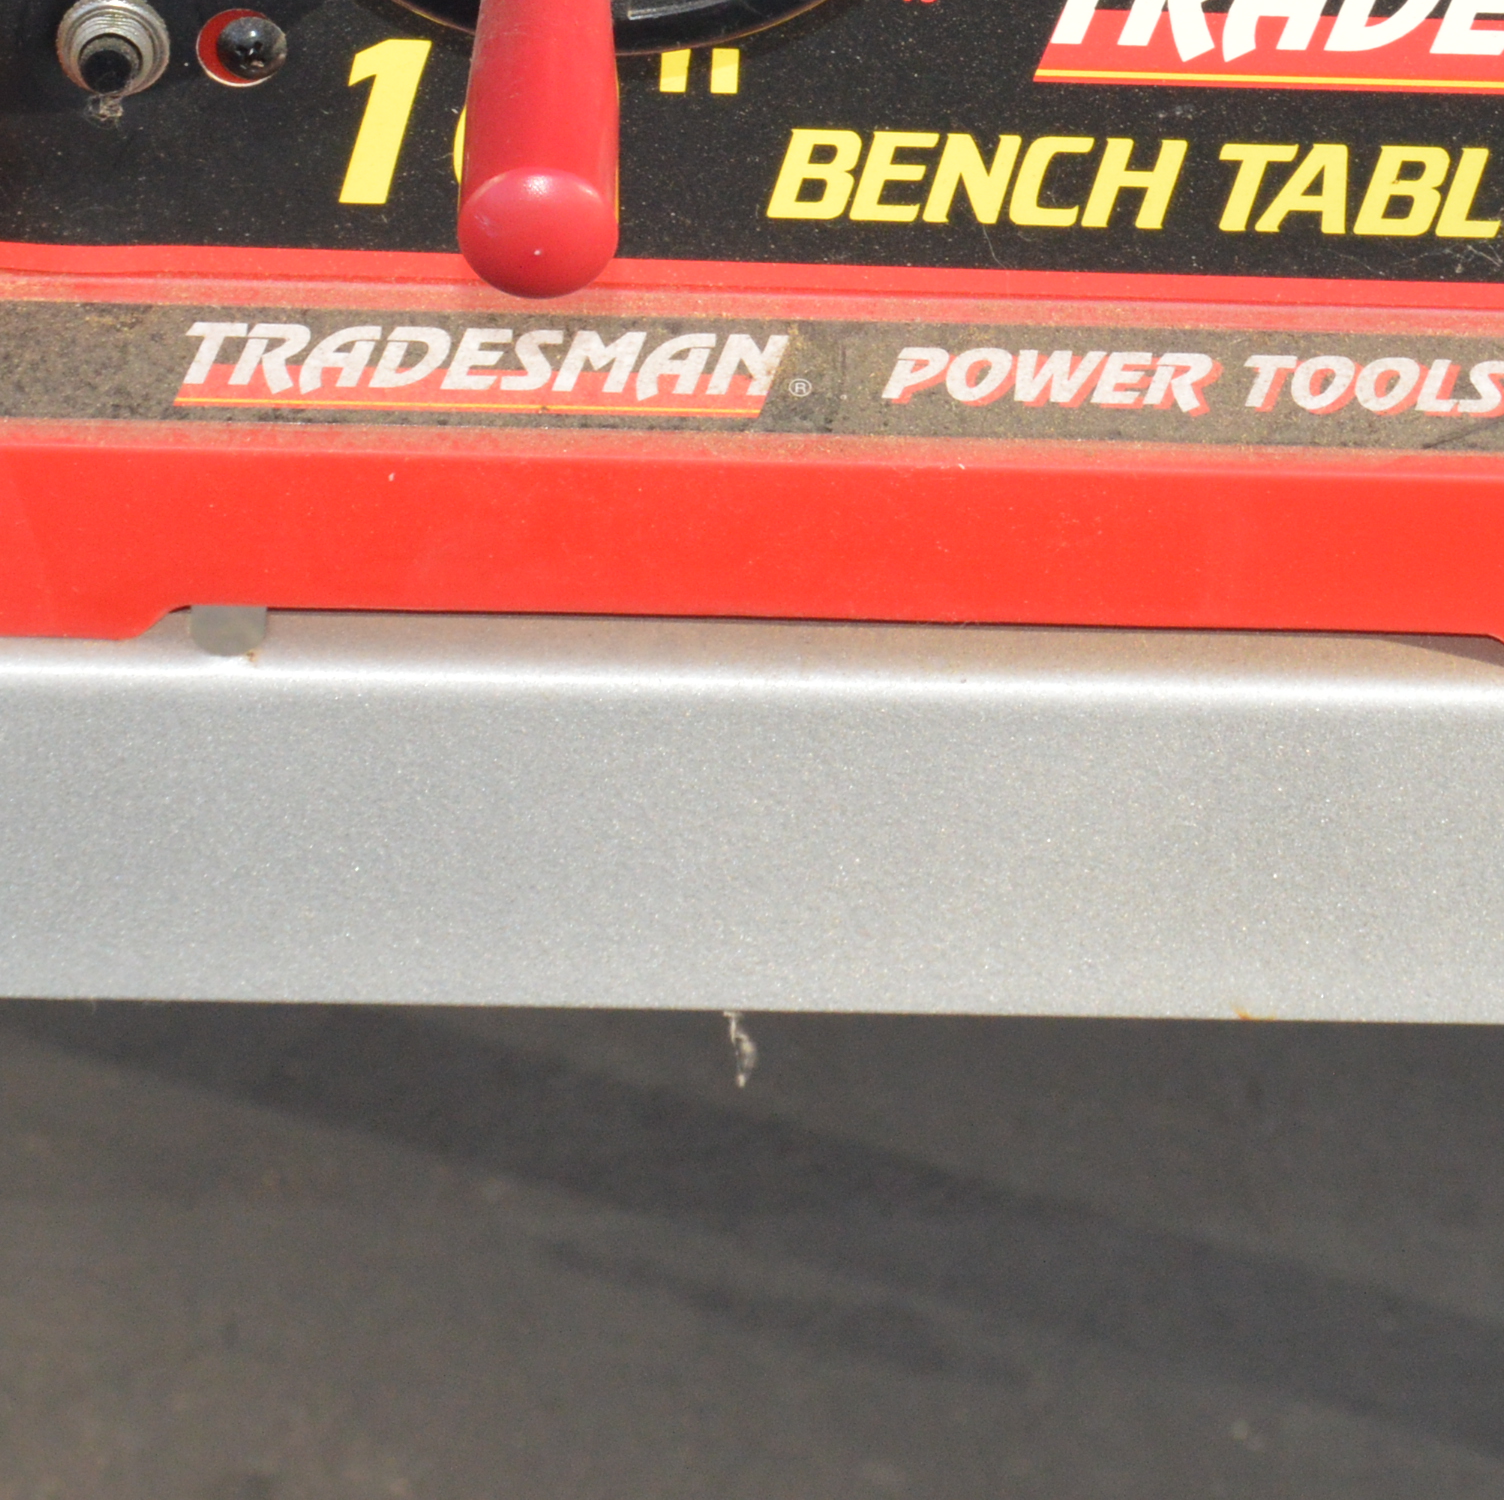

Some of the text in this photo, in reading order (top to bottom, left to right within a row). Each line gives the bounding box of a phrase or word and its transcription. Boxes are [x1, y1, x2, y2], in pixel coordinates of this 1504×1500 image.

[766, 128, 1188, 230] BENCH
[183, 321, 790, 401] TRADESMAN
[881, 346, 1214, 412] POWER
